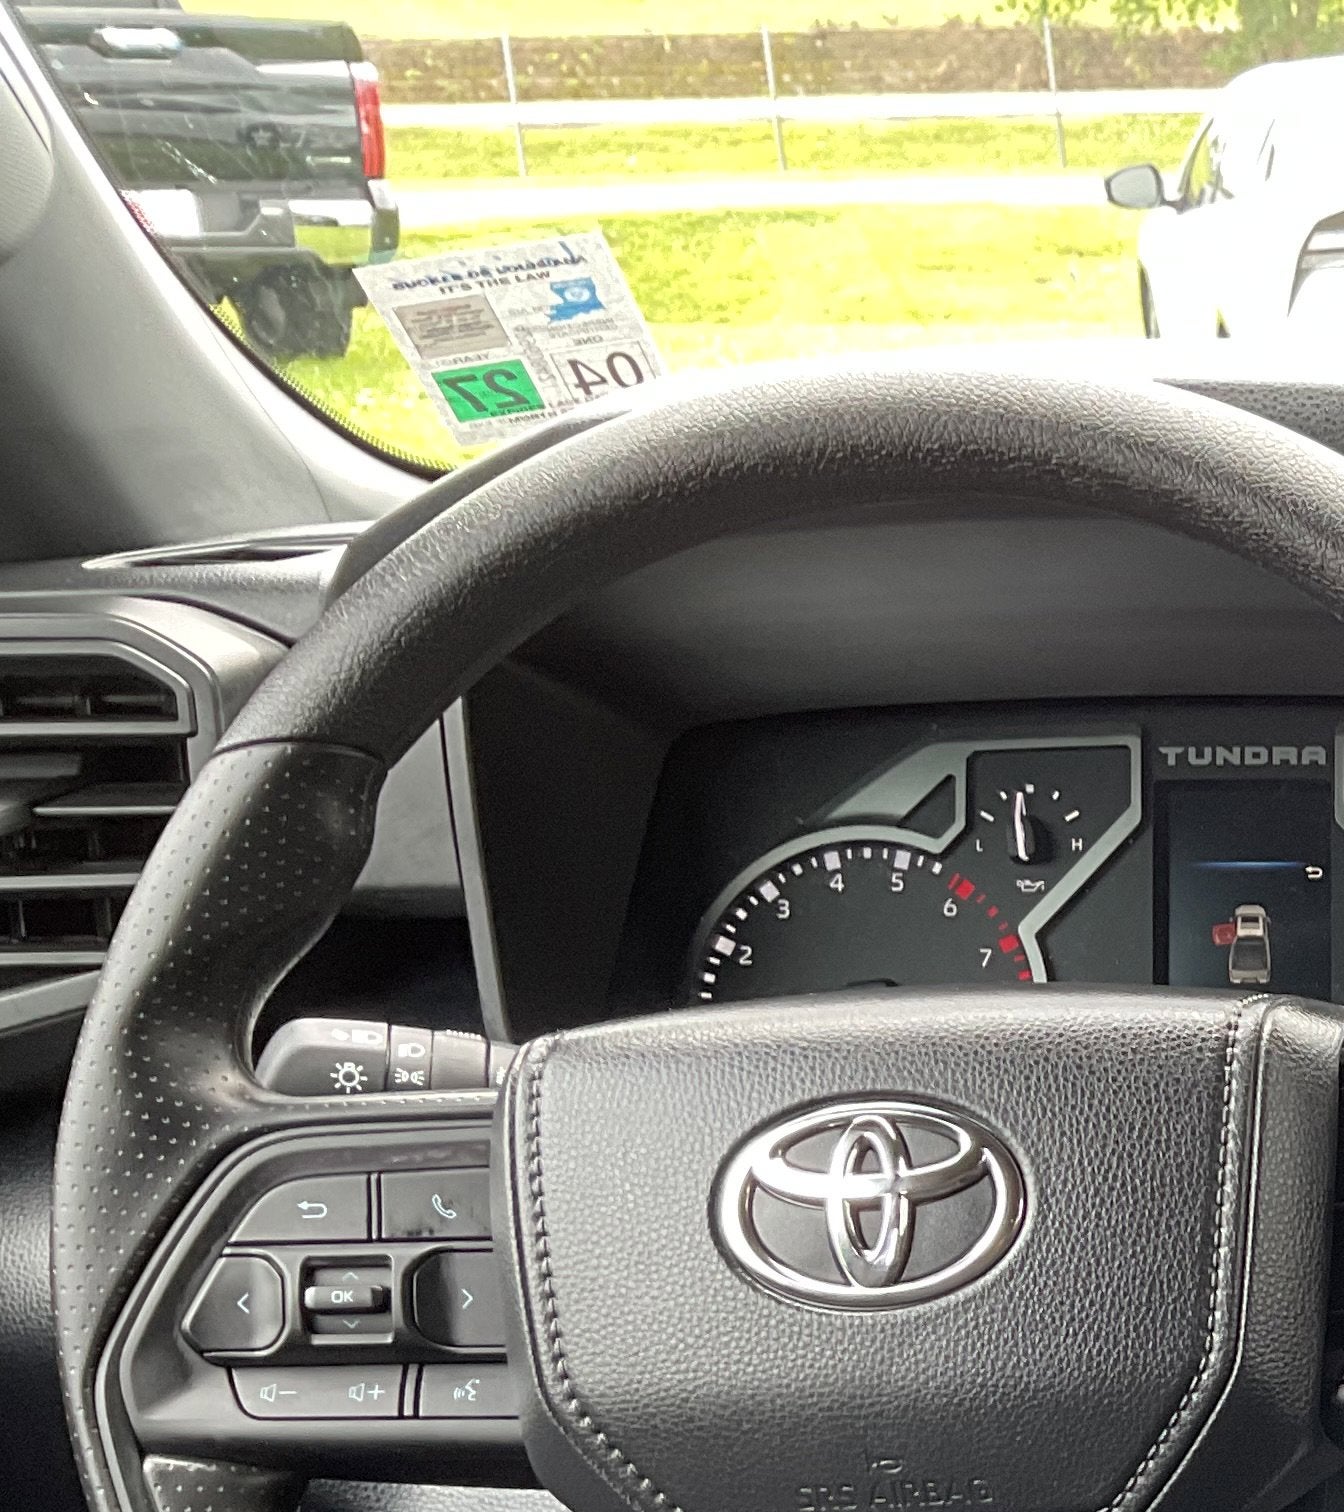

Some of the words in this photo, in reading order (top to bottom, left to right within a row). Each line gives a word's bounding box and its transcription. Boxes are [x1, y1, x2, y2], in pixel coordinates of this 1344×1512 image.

[1158, 745, 1328, 767] TUNDRA
[975, 839, 983, 852] L
[1071, 838, 1083, 852] H
[828, 873, 845, 892] 4
[891, 873, 904, 892] 5
[776, 899, 791, 920] 3
[943, 898, 958, 918] 6
[738, 946, 753, 967] 2
[979, 948, 993, 968] 7
[331, 1289, 354, 1303] OK
